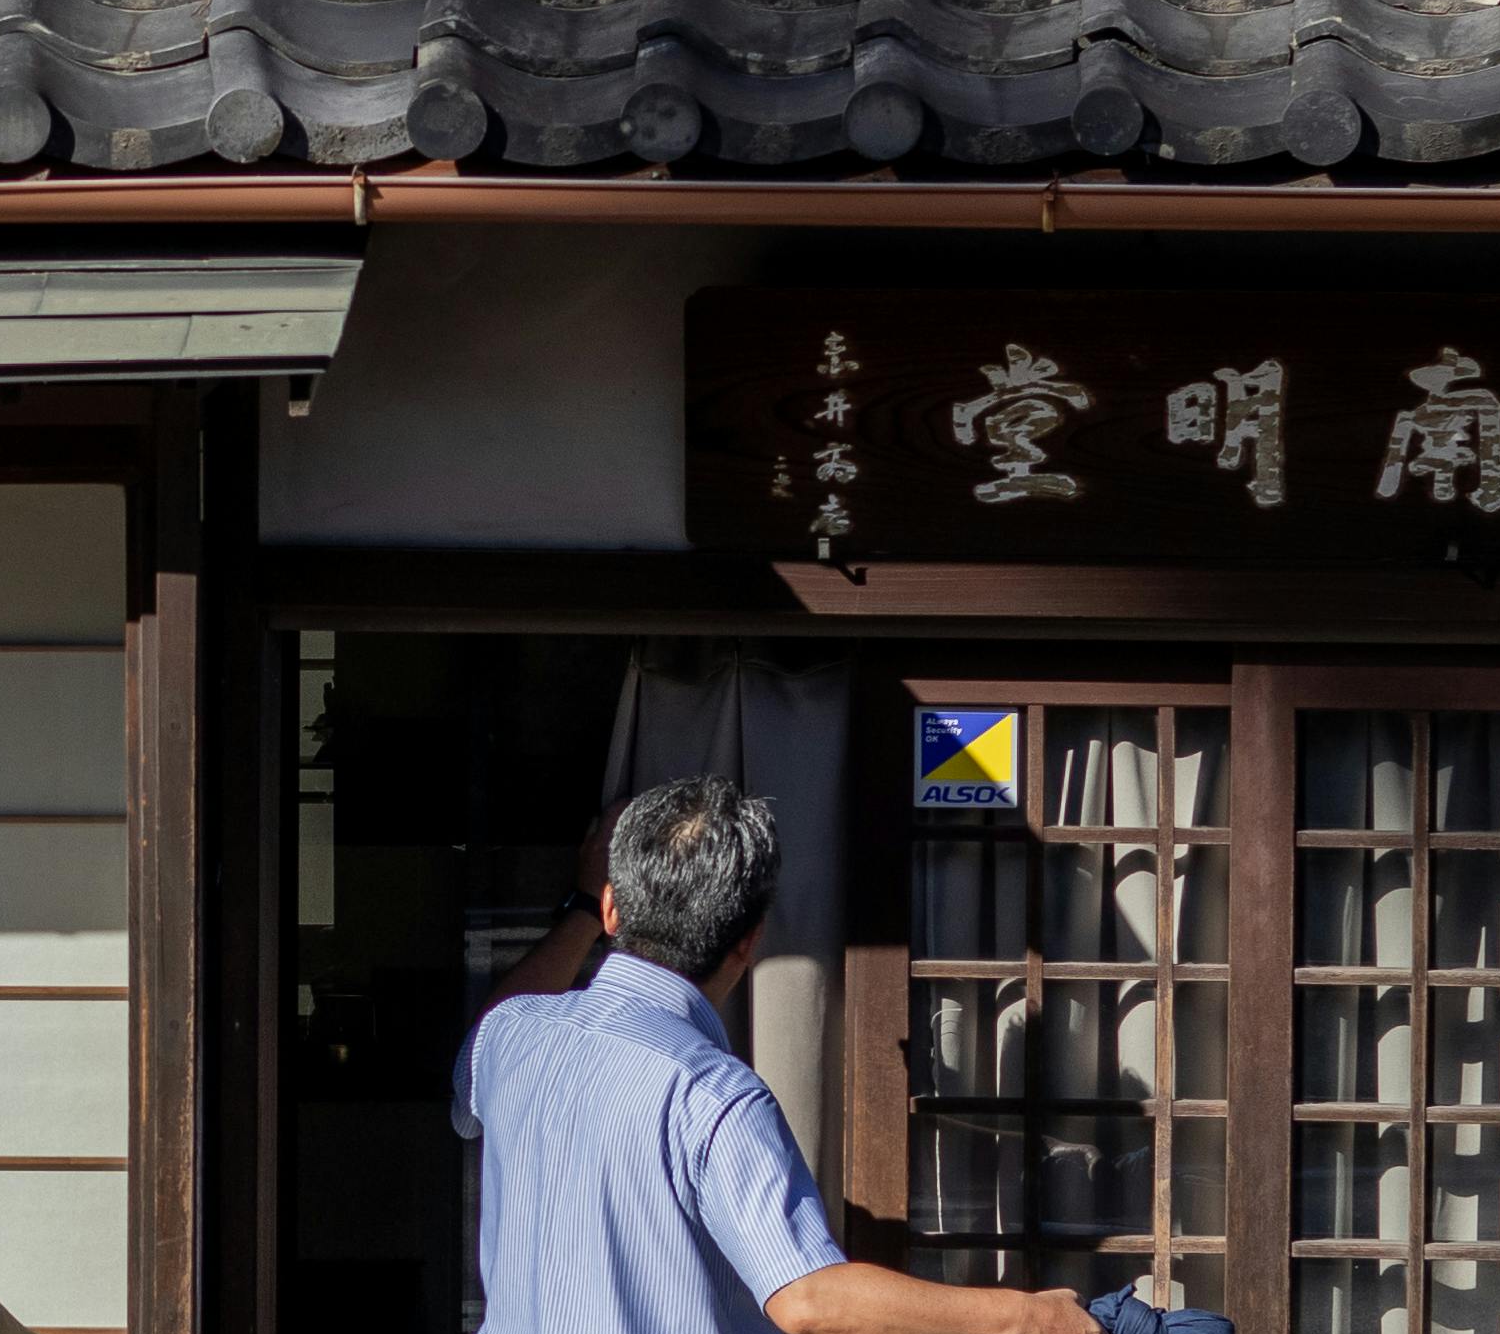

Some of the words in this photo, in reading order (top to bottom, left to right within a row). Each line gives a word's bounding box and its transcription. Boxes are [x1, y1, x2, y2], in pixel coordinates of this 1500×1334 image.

[925, 726, 963, 736] Security
[925, 735, 939, 743] OK
[921, 785, 1010, 804] ALSOK
